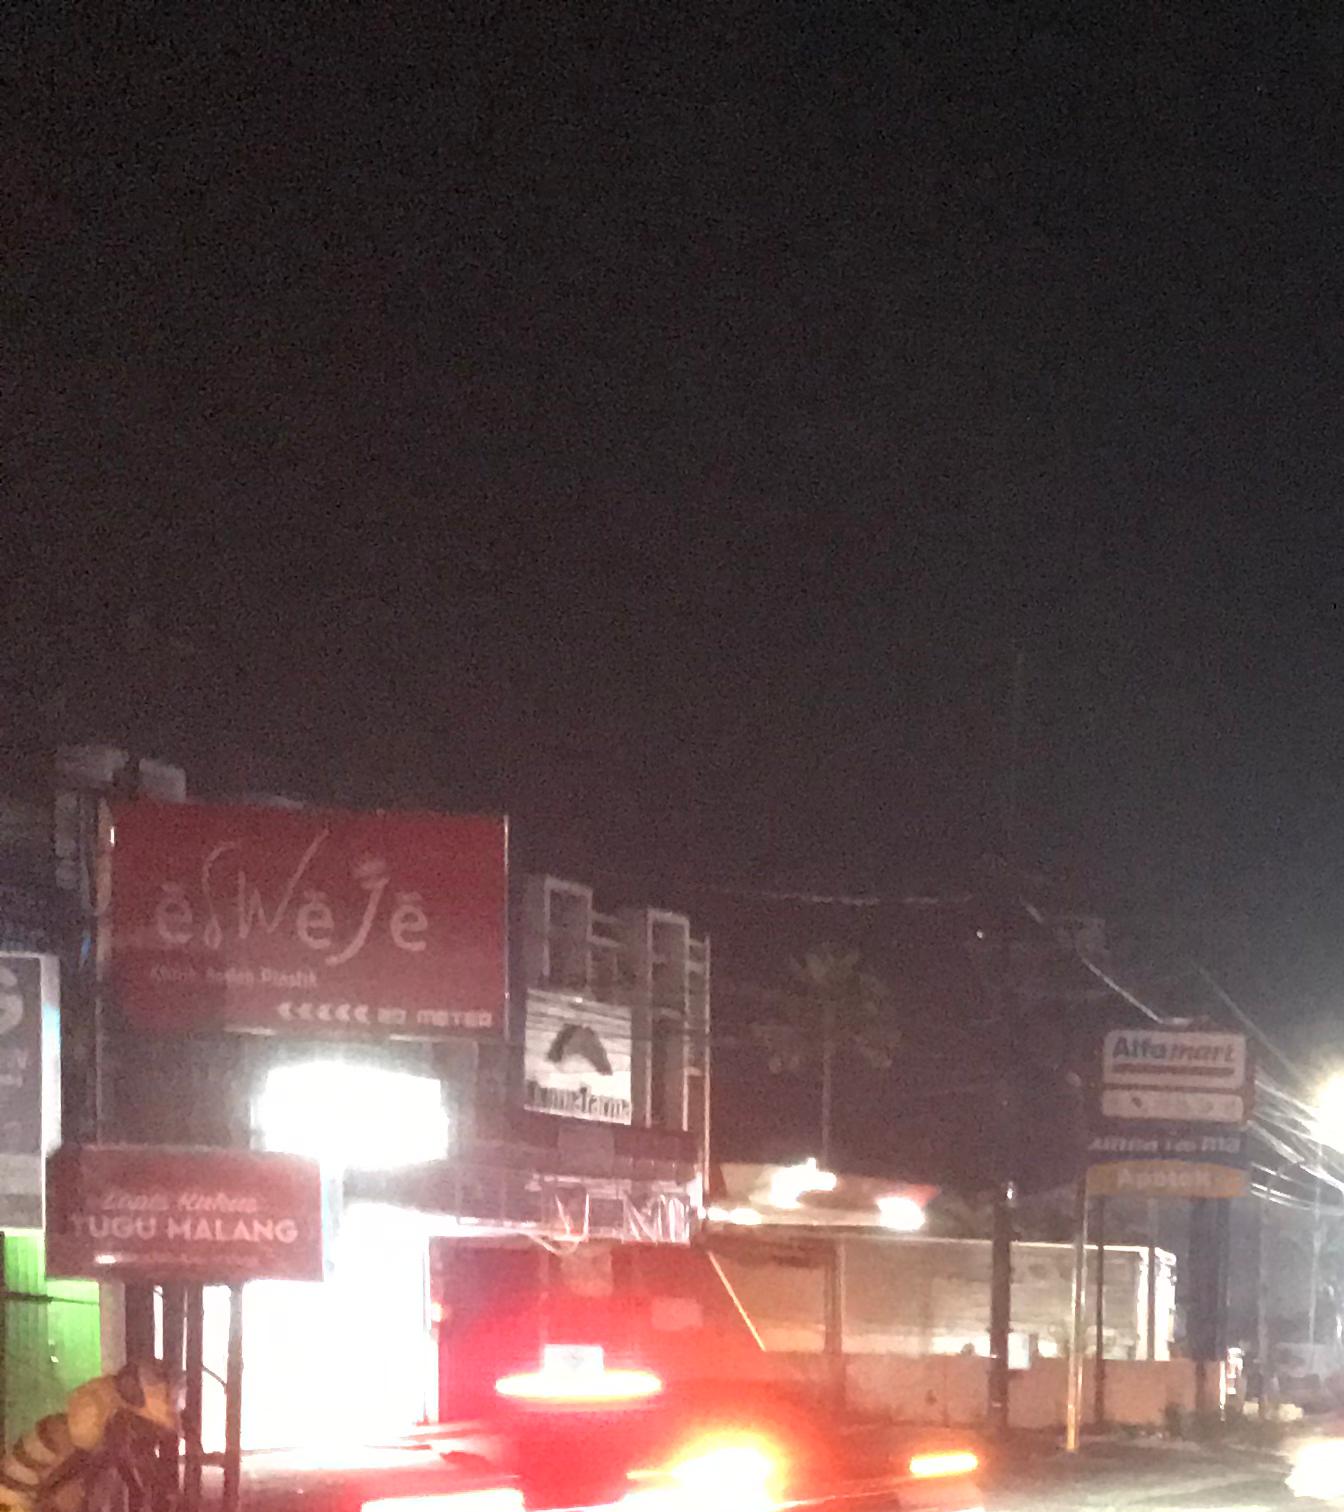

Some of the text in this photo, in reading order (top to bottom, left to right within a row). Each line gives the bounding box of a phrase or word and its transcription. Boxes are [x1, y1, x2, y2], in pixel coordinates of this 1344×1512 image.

[1111, 1035, 1236, 1063] Alfamart
[70, 1212, 299, 1244] TUGU MALANG
